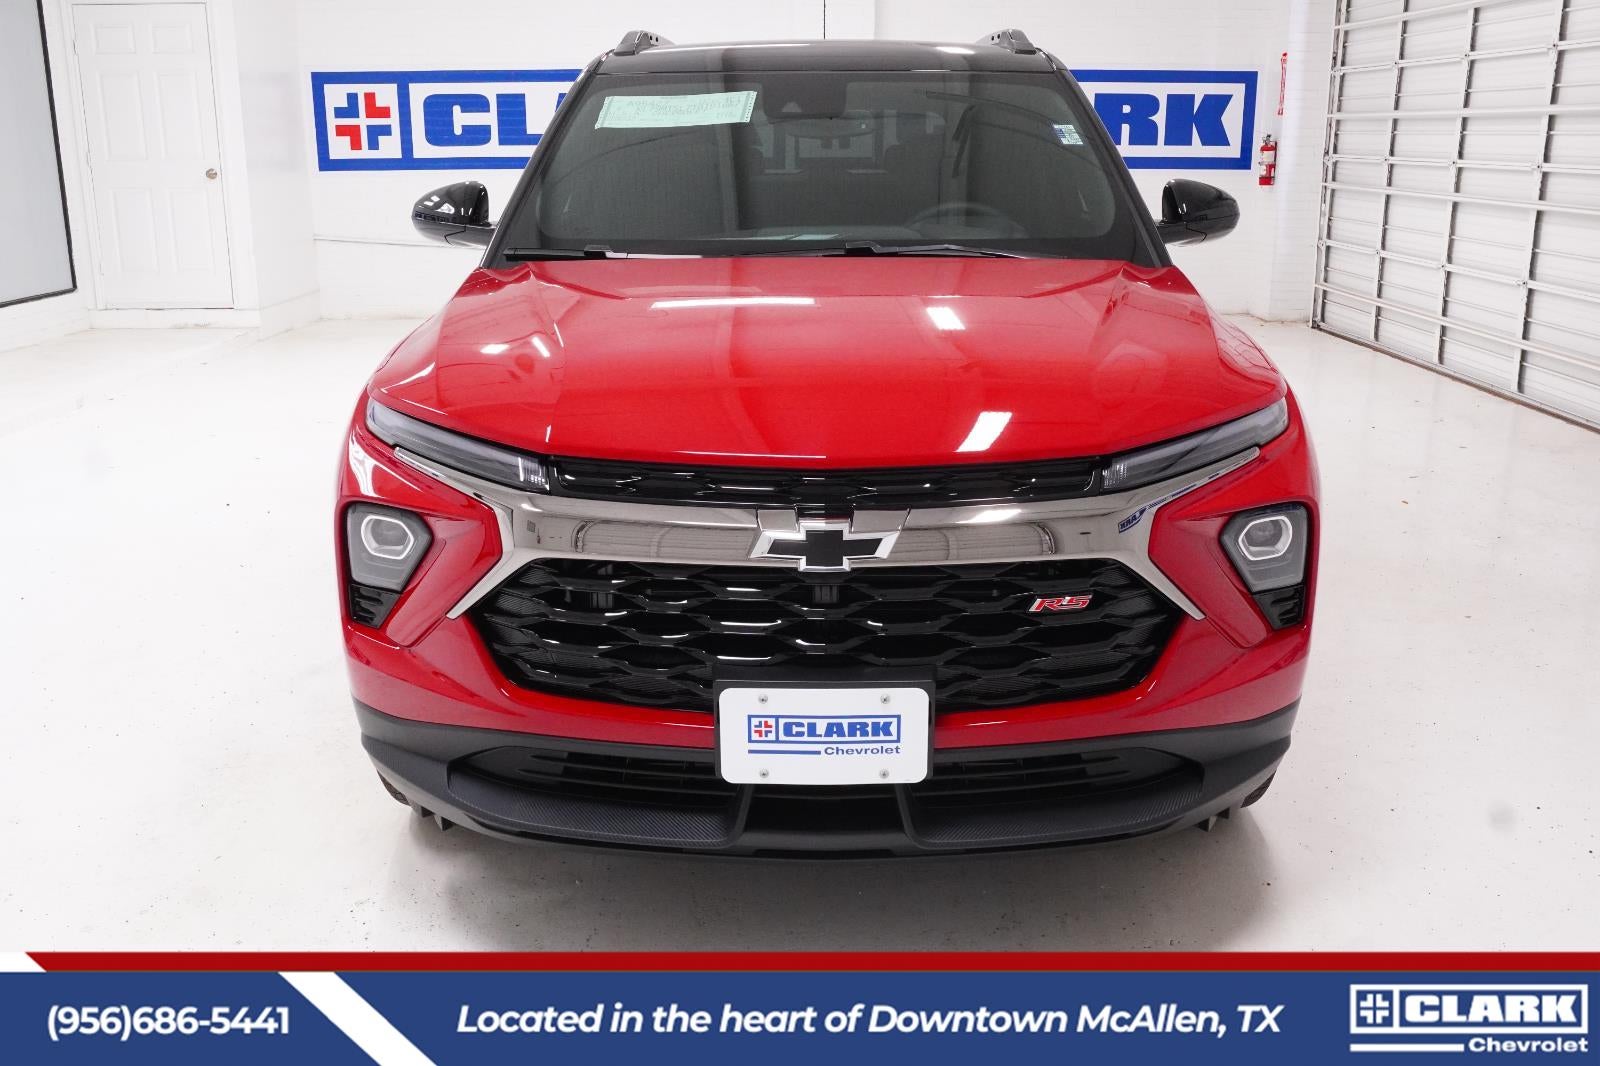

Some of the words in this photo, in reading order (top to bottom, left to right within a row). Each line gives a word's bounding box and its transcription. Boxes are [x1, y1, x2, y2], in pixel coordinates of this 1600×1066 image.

[423, 93, 568, 147] CL
[1029, 595, 1093, 613] RS
[783, 721, 893, 738] CLARK
[824, 745, 901, 756] Chevrolet
